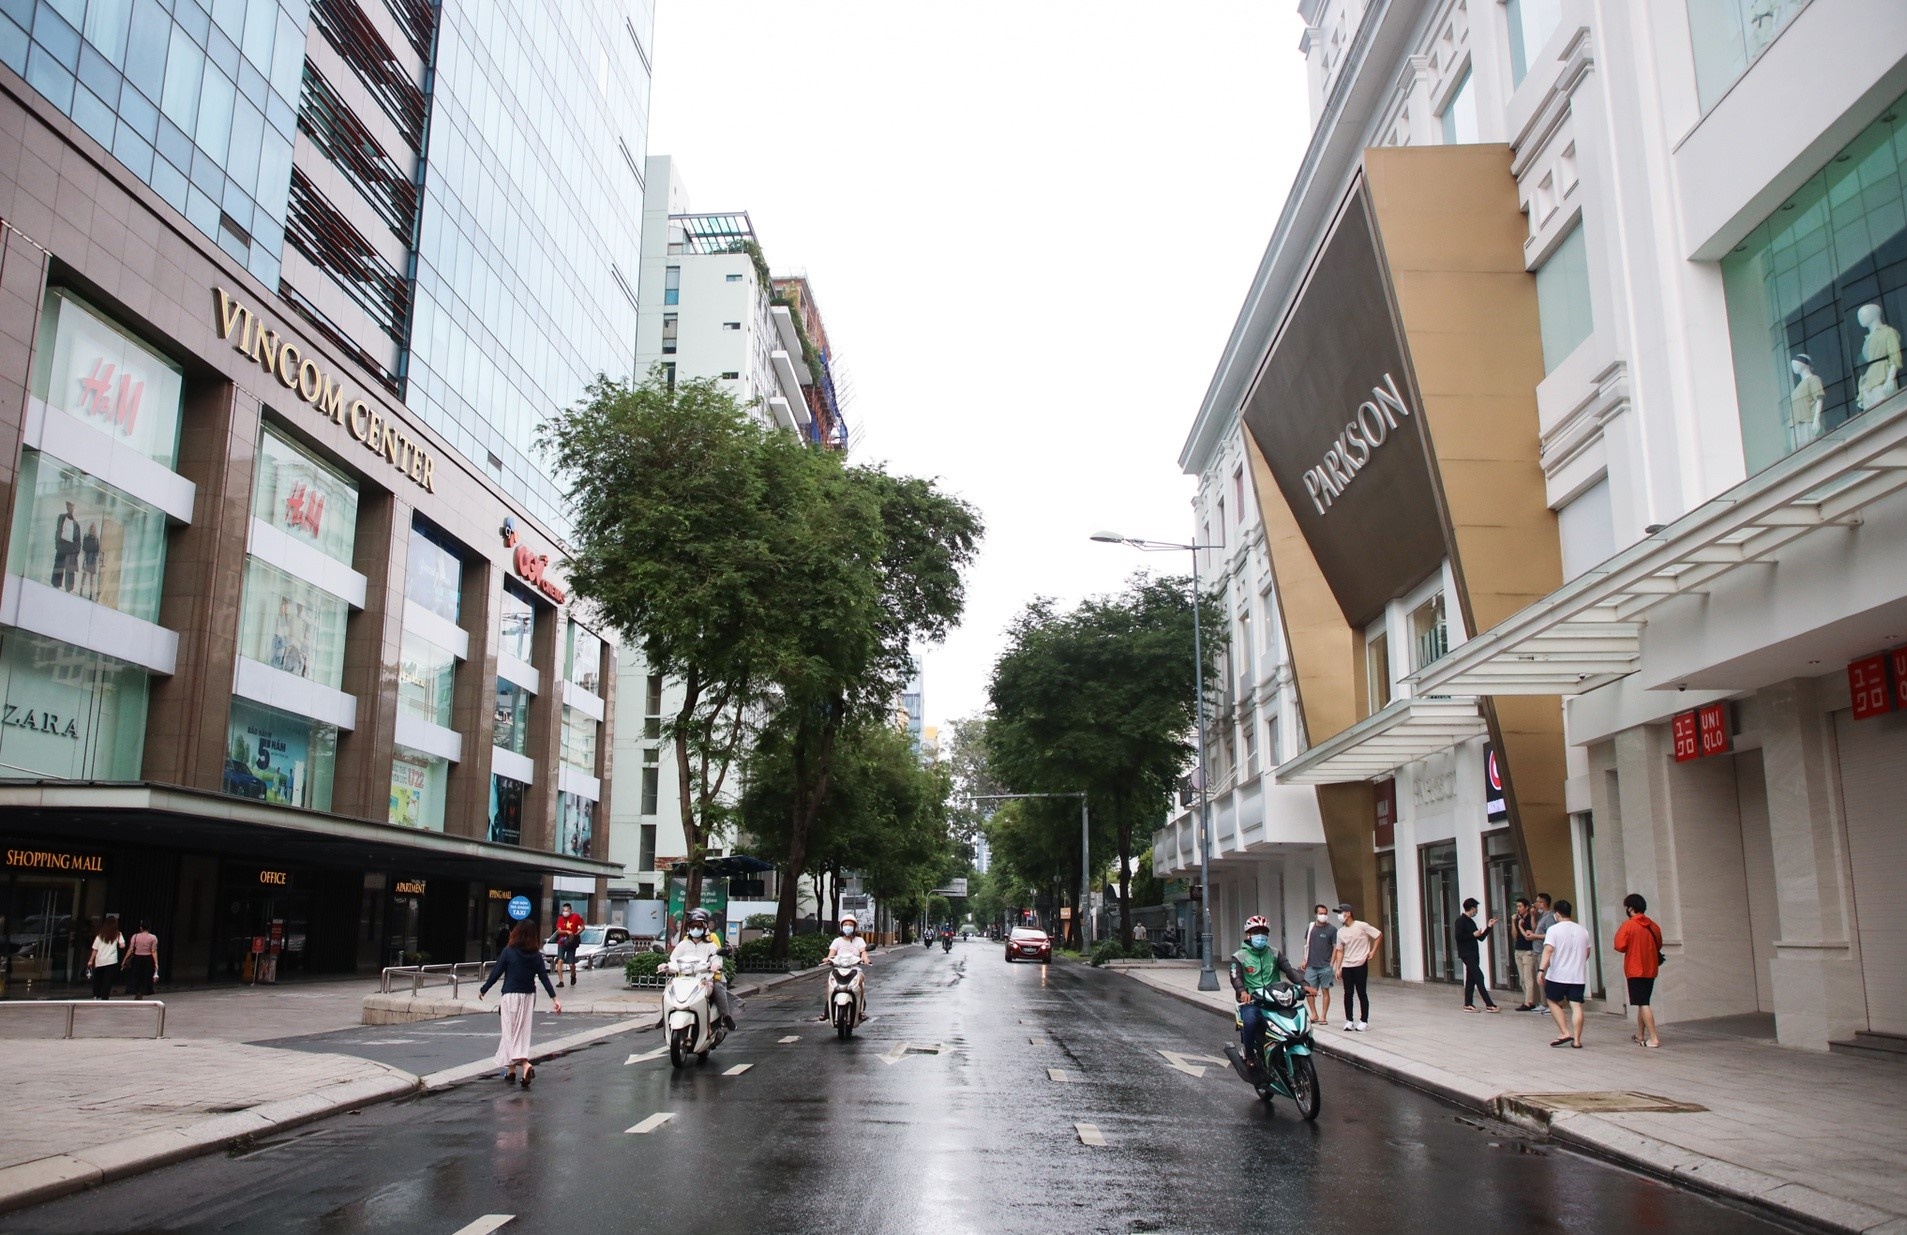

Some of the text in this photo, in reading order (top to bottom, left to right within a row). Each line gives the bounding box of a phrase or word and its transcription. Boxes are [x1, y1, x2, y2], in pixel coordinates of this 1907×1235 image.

[78, 356, 145, 437] H&M
[215, 286, 437, 494] VINCOM CENTER
[1302, 372, 1410, 517] PARKSON
[284, 479, 326, 539] H&M
[1, 703, 80, 740] ZARA
[1701, 710, 1720, 730] UNI
[256, 738, 271, 771] 5
[1703, 730, 1723, 752] QLO
[6, 849, 103, 871] SHOPPING MALL
[260, 870, 287, 885] OFFICE
[395, 882, 426, 894] APARTMENT
